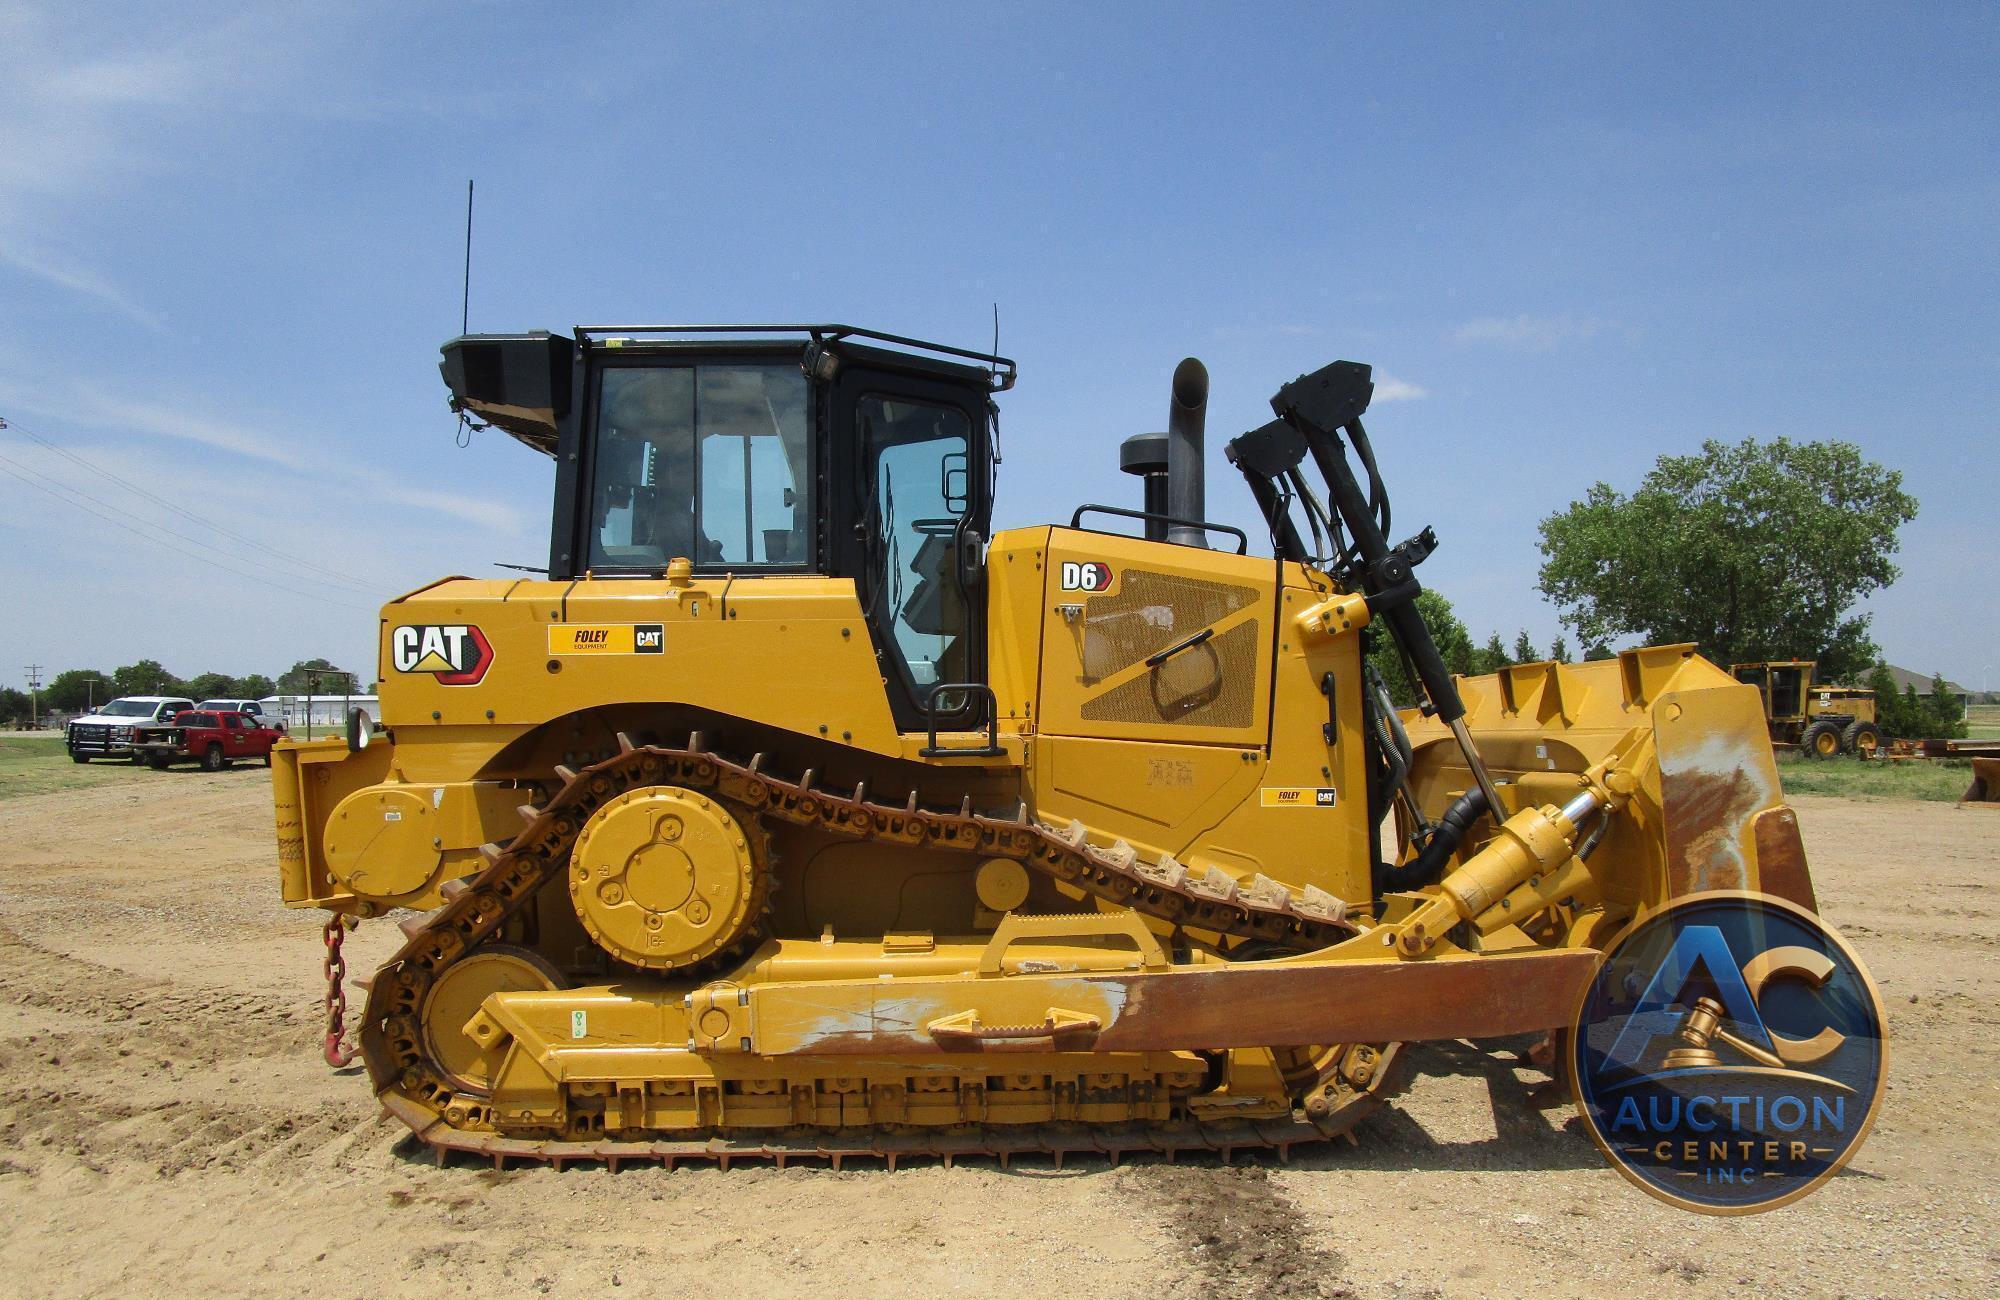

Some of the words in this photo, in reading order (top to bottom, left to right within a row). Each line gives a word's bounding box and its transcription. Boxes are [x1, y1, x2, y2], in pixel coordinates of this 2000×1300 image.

[1063, 562, 1097, 590] D6
[574, 630, 609, 643] FOLEY
[636, 631, 660, 647] CAT
[393, 625, 468, 672] CAT
[1278, 791, 1300, 799] FOLEY
[1317, 792, 1334, 802] CAT
